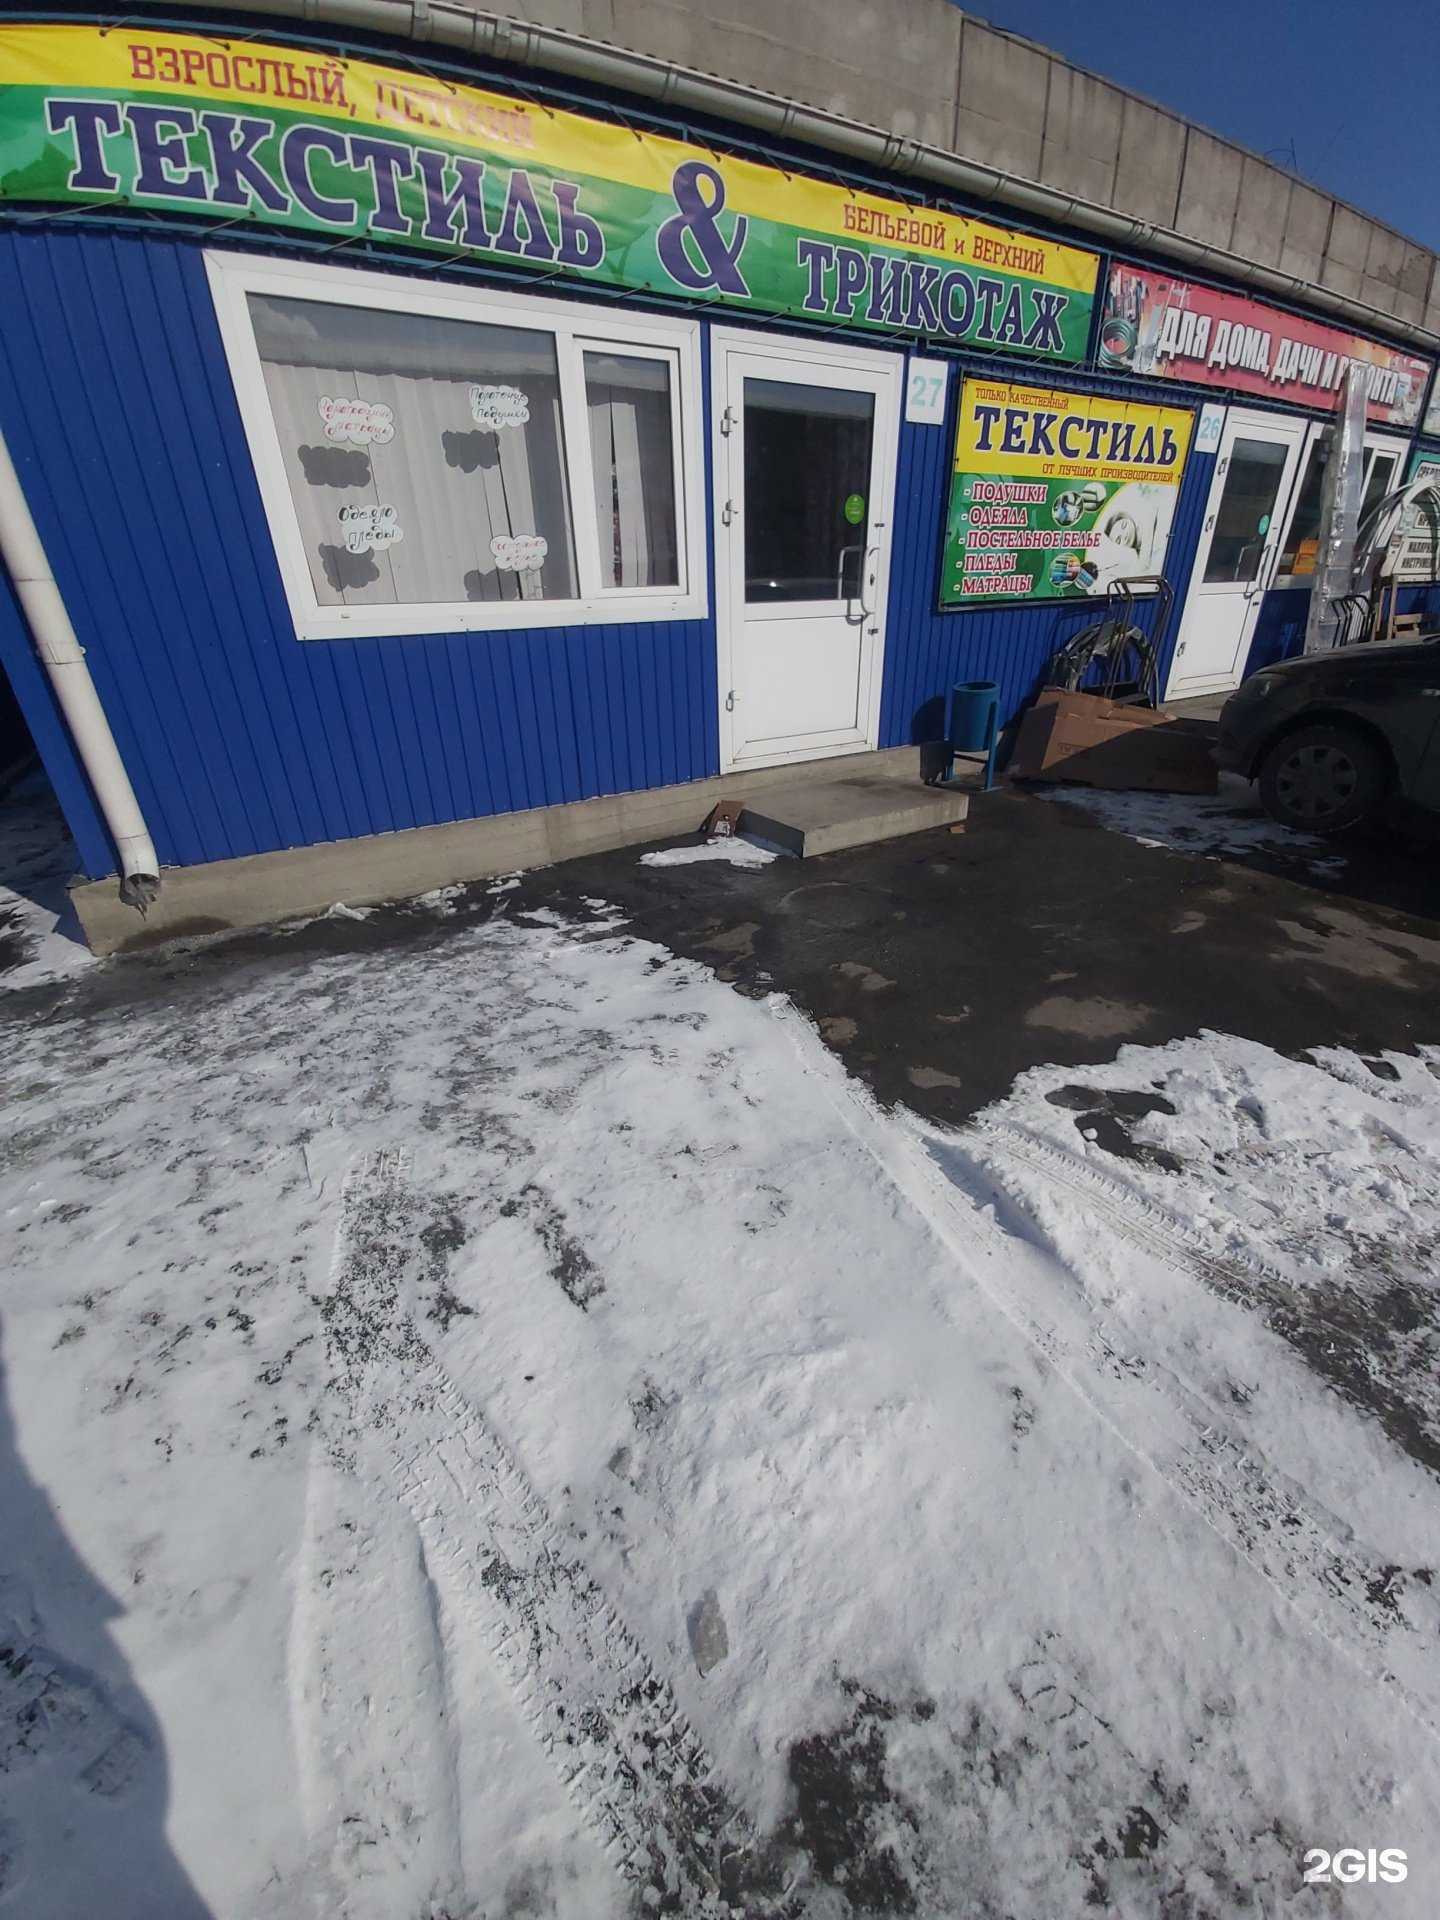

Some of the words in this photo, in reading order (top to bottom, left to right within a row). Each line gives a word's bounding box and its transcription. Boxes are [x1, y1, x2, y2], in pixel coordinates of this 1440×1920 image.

[128, 44, 357, 117] ВЗРОСЛЫЙ,
[44, 97, 606, 269] ТЕКСТИЛЬ
[656, 159, 752, 298] &
[844, 203, 946, 251] БЕЛЬЕВОЙ
[972, 235, 1045, 275] ВЕРХНИЙ
[797, 237, 1069, 354] ТРИКОТАЖ
[1156, 305, 1212, 360] ДЛЯ
[1207, 319, 1272, 376] ДОМА,
[1270, 337, 1324, 386] ДАЧИ
[1319, 351, 1338, 389] И
[912, 375, 943, 407] 27
[975, 387, 1007, 402] ТОЛЬКО
[973, 404, 1178, 466] ТЕКСТИЛЬ
[1199, 416, 1219, 440] 26
[1042, 463, 1053, 474] ОТ
[1058, 464, 1097, 478] ЛУЧШИХ
[1100, 467, 1174, 482] ПРОИЗВОДИТЕЛЕЙ
[972, 482, 1047, 504] ПОДУШКИ
[970, 506, 1028, 528] ОДЕЯЛА
[966, 531, 1060, 549] ПОСТЕЛЬНОЕ
[1062, 531, 1102, 549] БЕЛЬЕ
[964, 554, 1017, 574] ПЛЕДЫ
[961, 575, 1033, 595] МАТРАЦЫ
